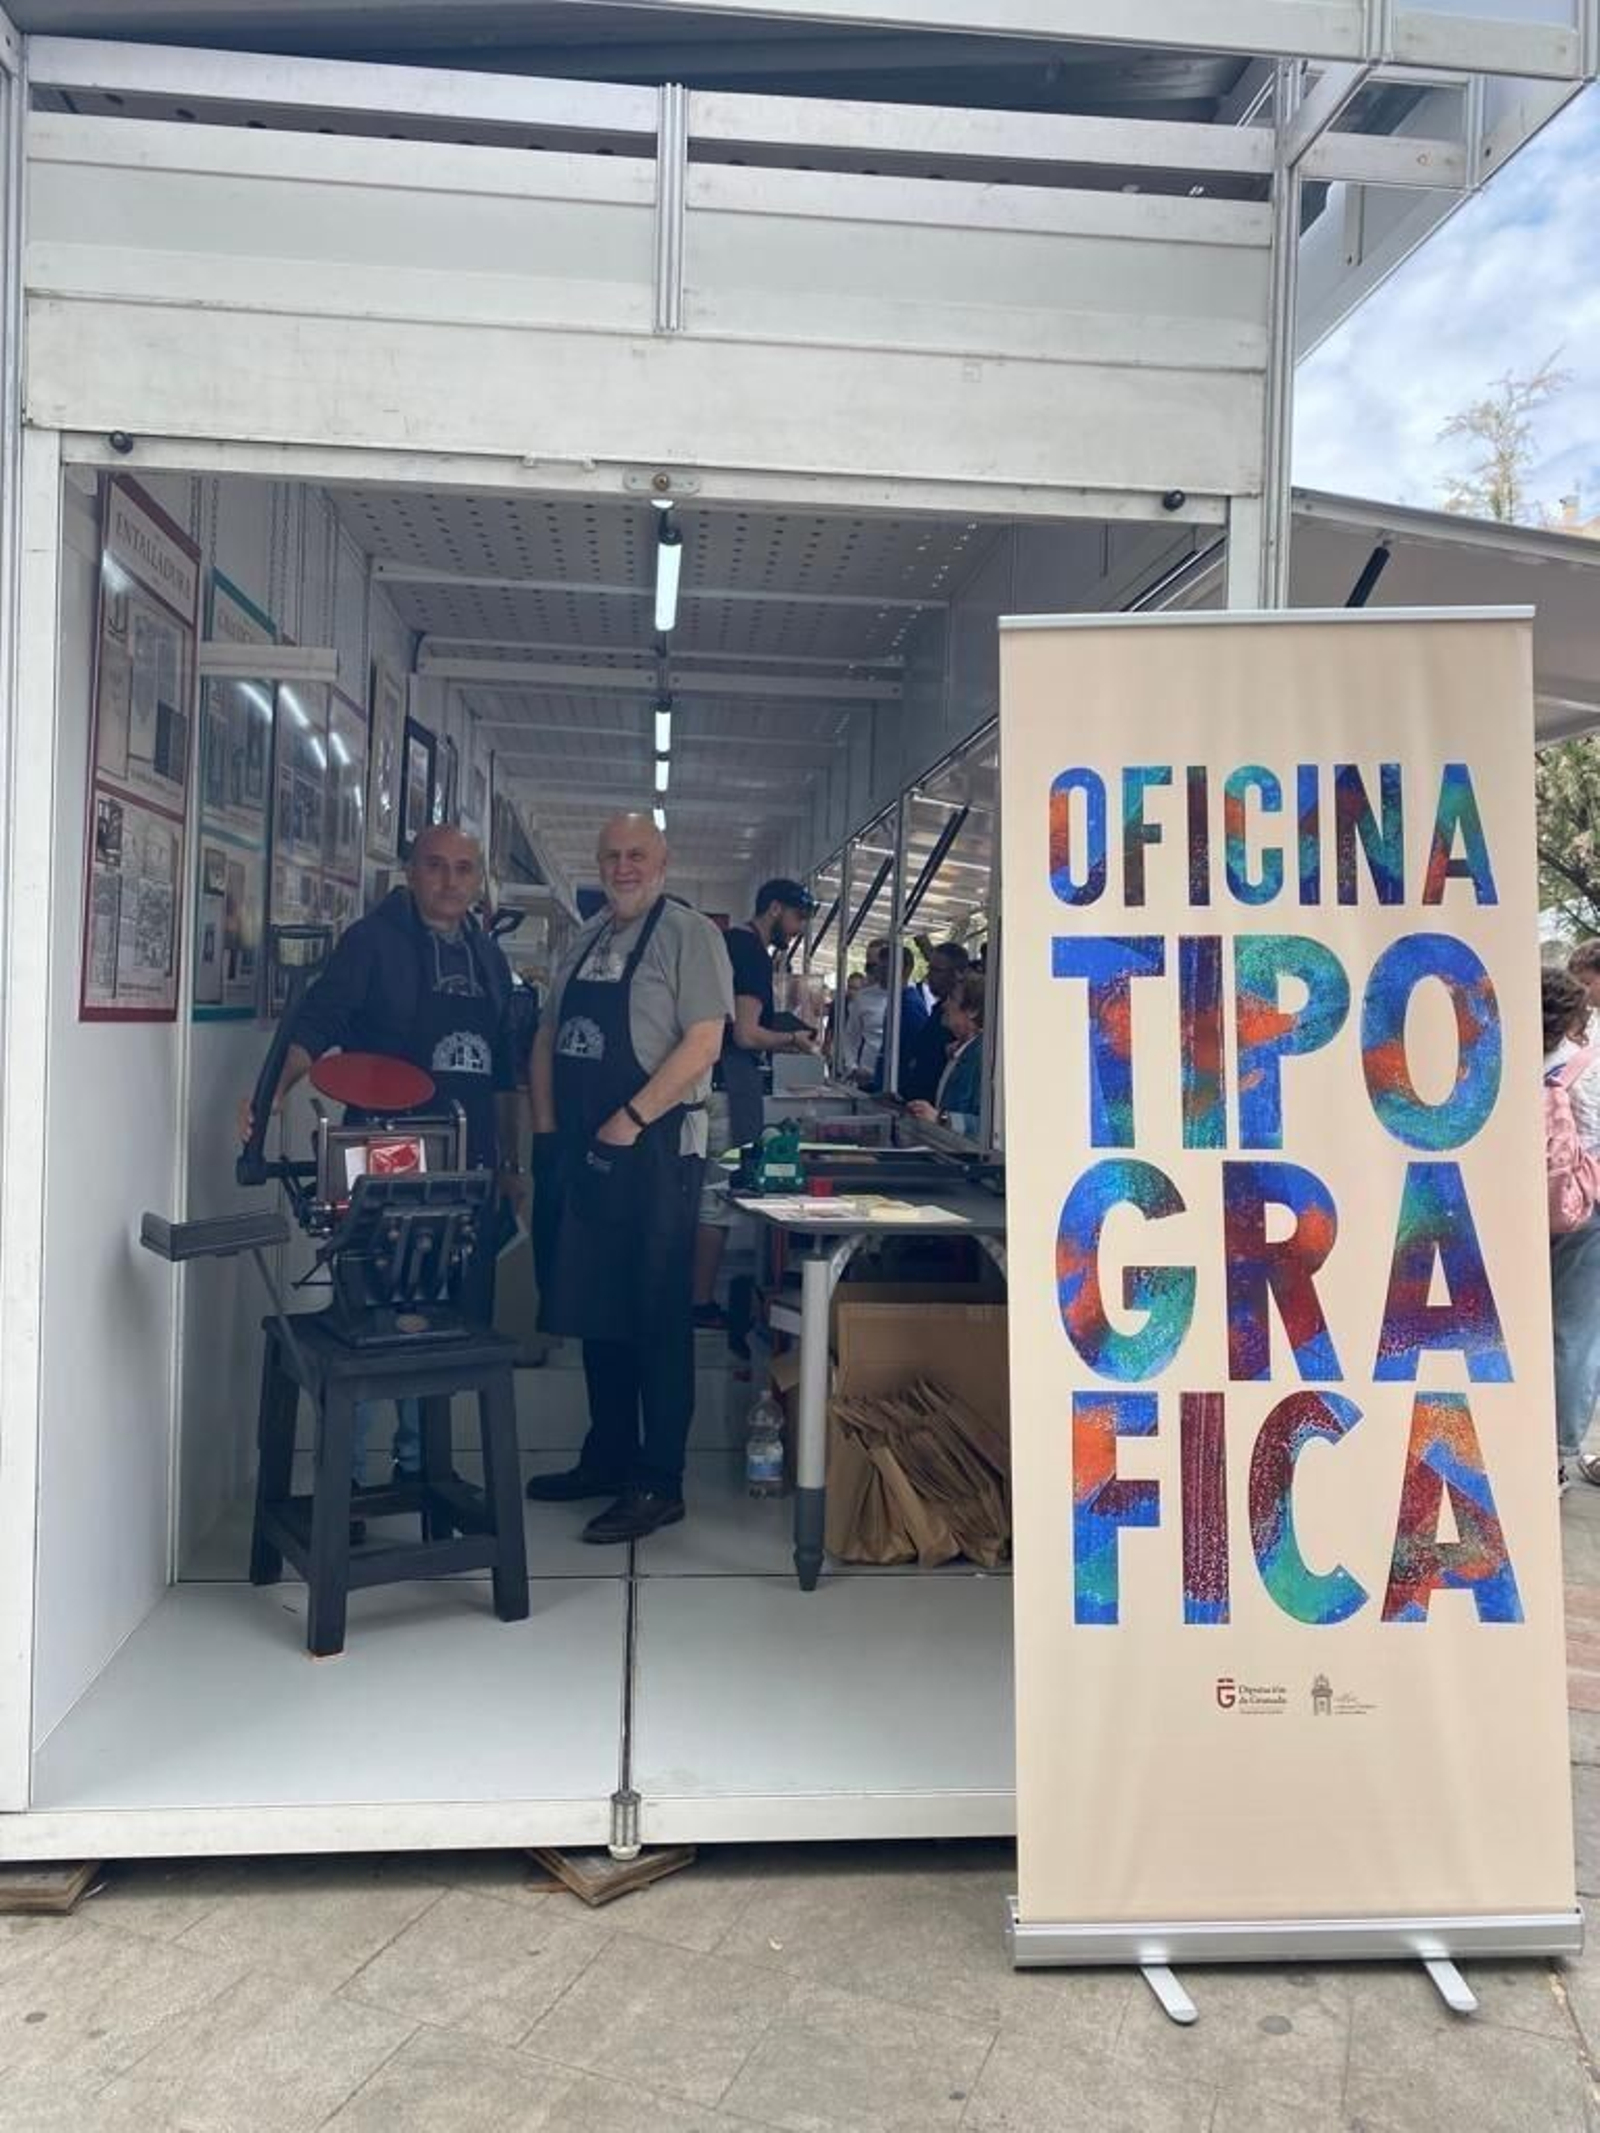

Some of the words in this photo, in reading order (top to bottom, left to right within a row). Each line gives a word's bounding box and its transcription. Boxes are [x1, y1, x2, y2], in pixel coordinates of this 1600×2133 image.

[115, 511, 191, 600] ENTALLADURA
[1049, 763, 1498, 907] OFICINA
[1051, 932, 1502, 1151] TIPO
[1055, 1157, 1515, 1383] GRA
[1072, 1390, 1526, 1625] FICA
